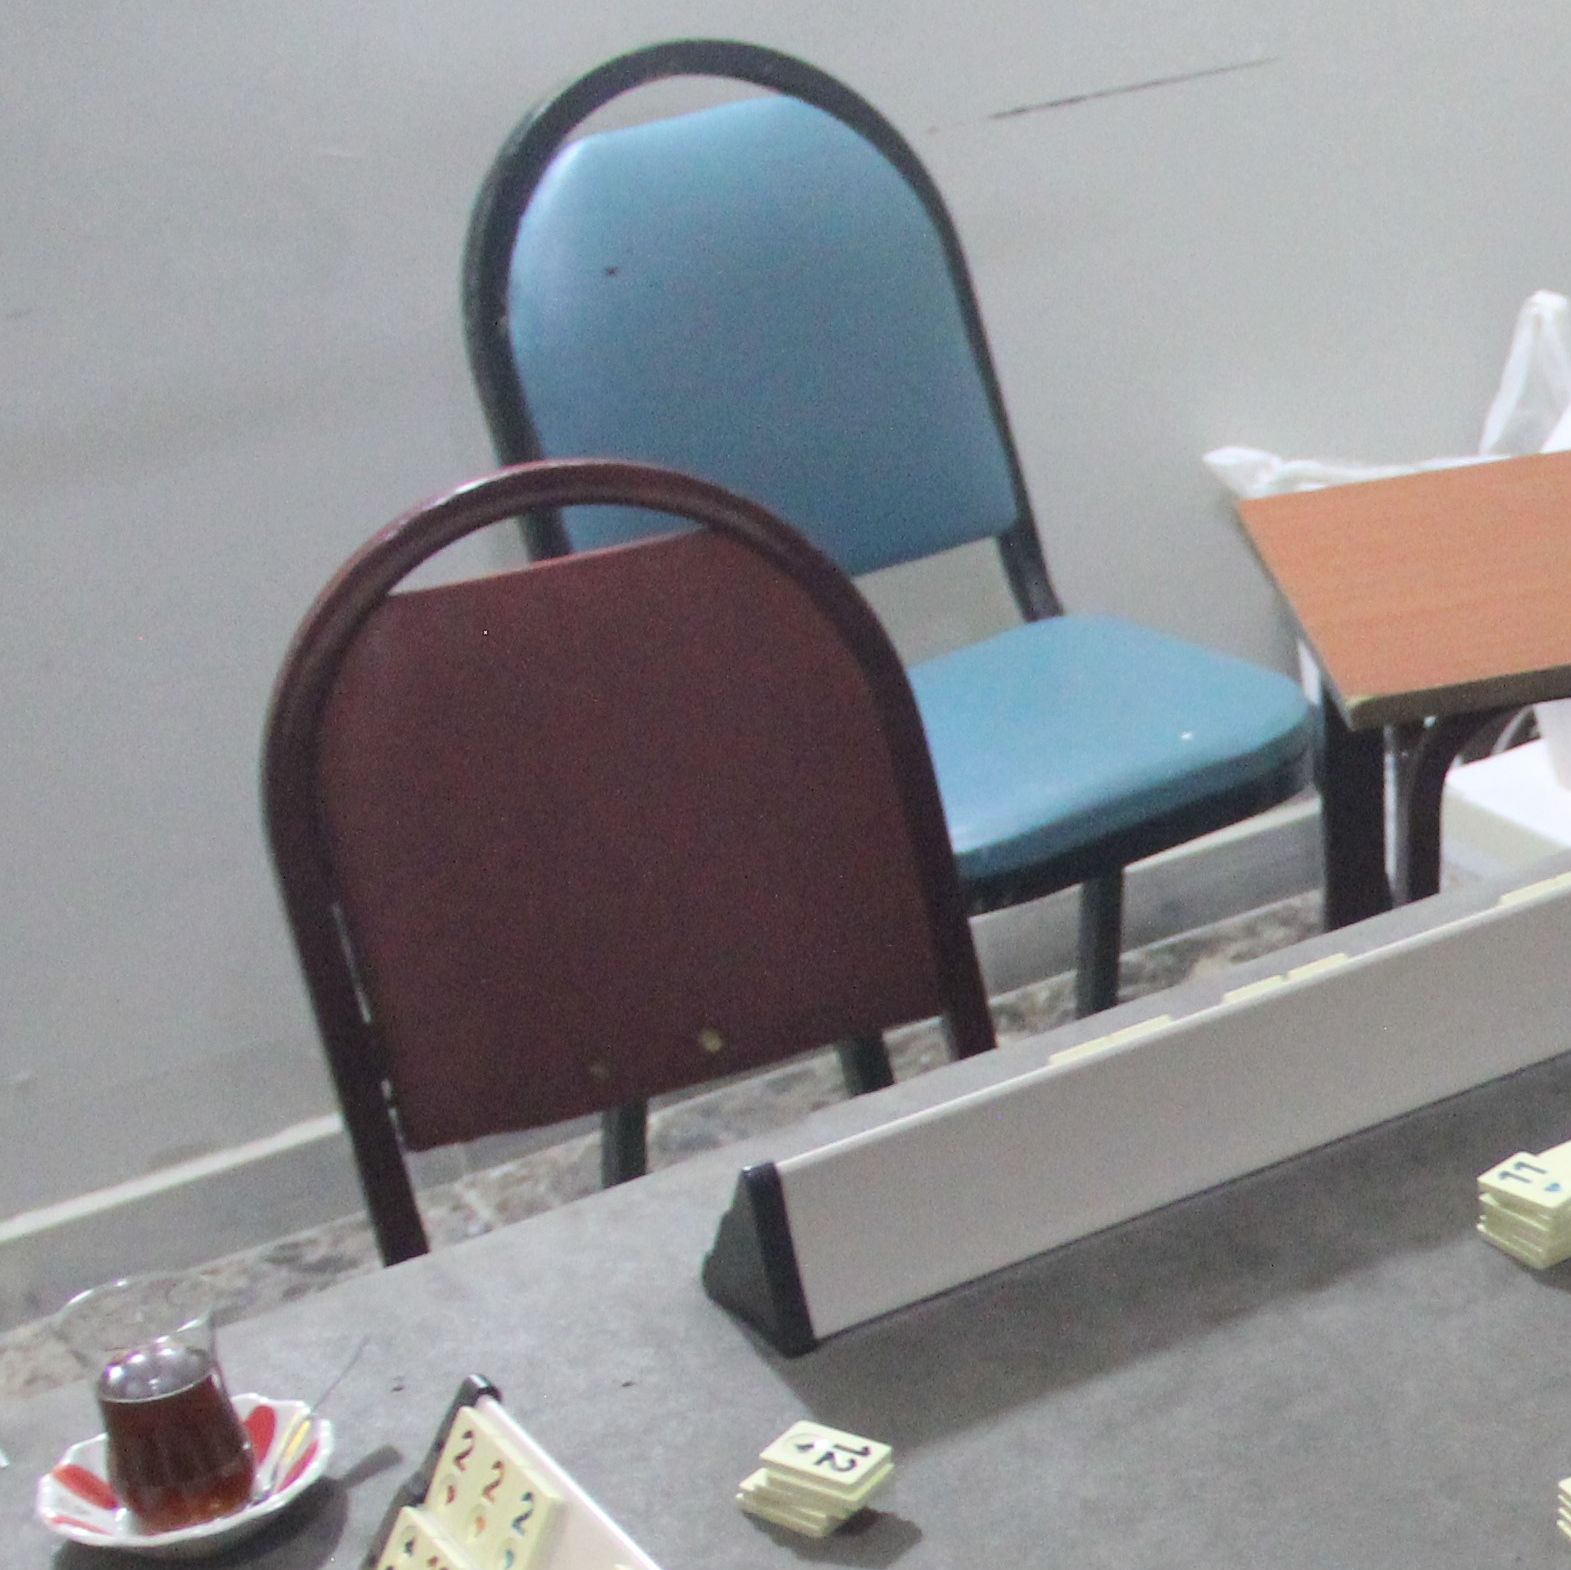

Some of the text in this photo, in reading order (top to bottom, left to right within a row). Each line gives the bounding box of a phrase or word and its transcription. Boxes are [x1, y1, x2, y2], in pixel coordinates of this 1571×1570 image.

[1499, 1161, 1548, 1183] 11
[454, 1430, 474, 1472] 2
[483, 1460, 504, 1503] 2
[511, 1491, 534, 1536] 2
